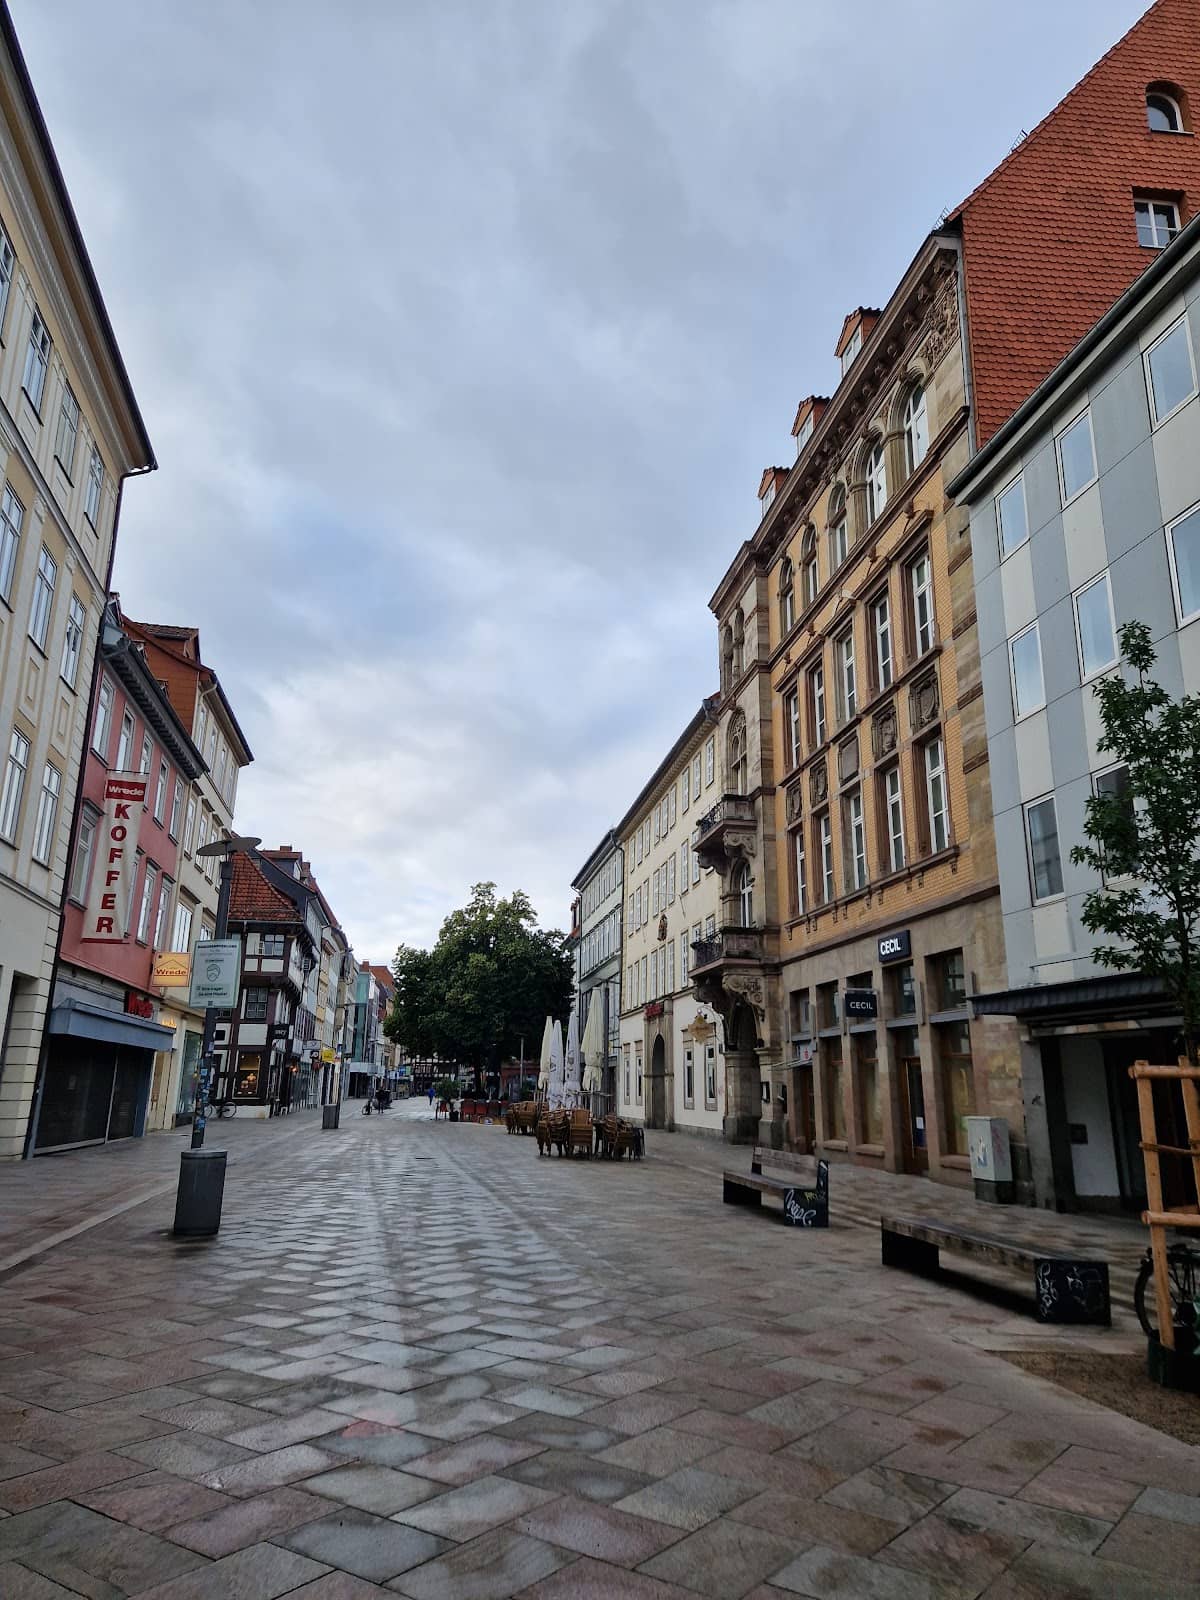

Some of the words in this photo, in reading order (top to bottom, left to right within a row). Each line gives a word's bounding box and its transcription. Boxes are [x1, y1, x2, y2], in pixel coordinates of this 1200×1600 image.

[108, 785, 145, 796] Wrede
[95, 803, 131, 934] KOFFER
[880, 938, 901, 955] CECIL
[849, 1001, 873, 1010] CECIL
